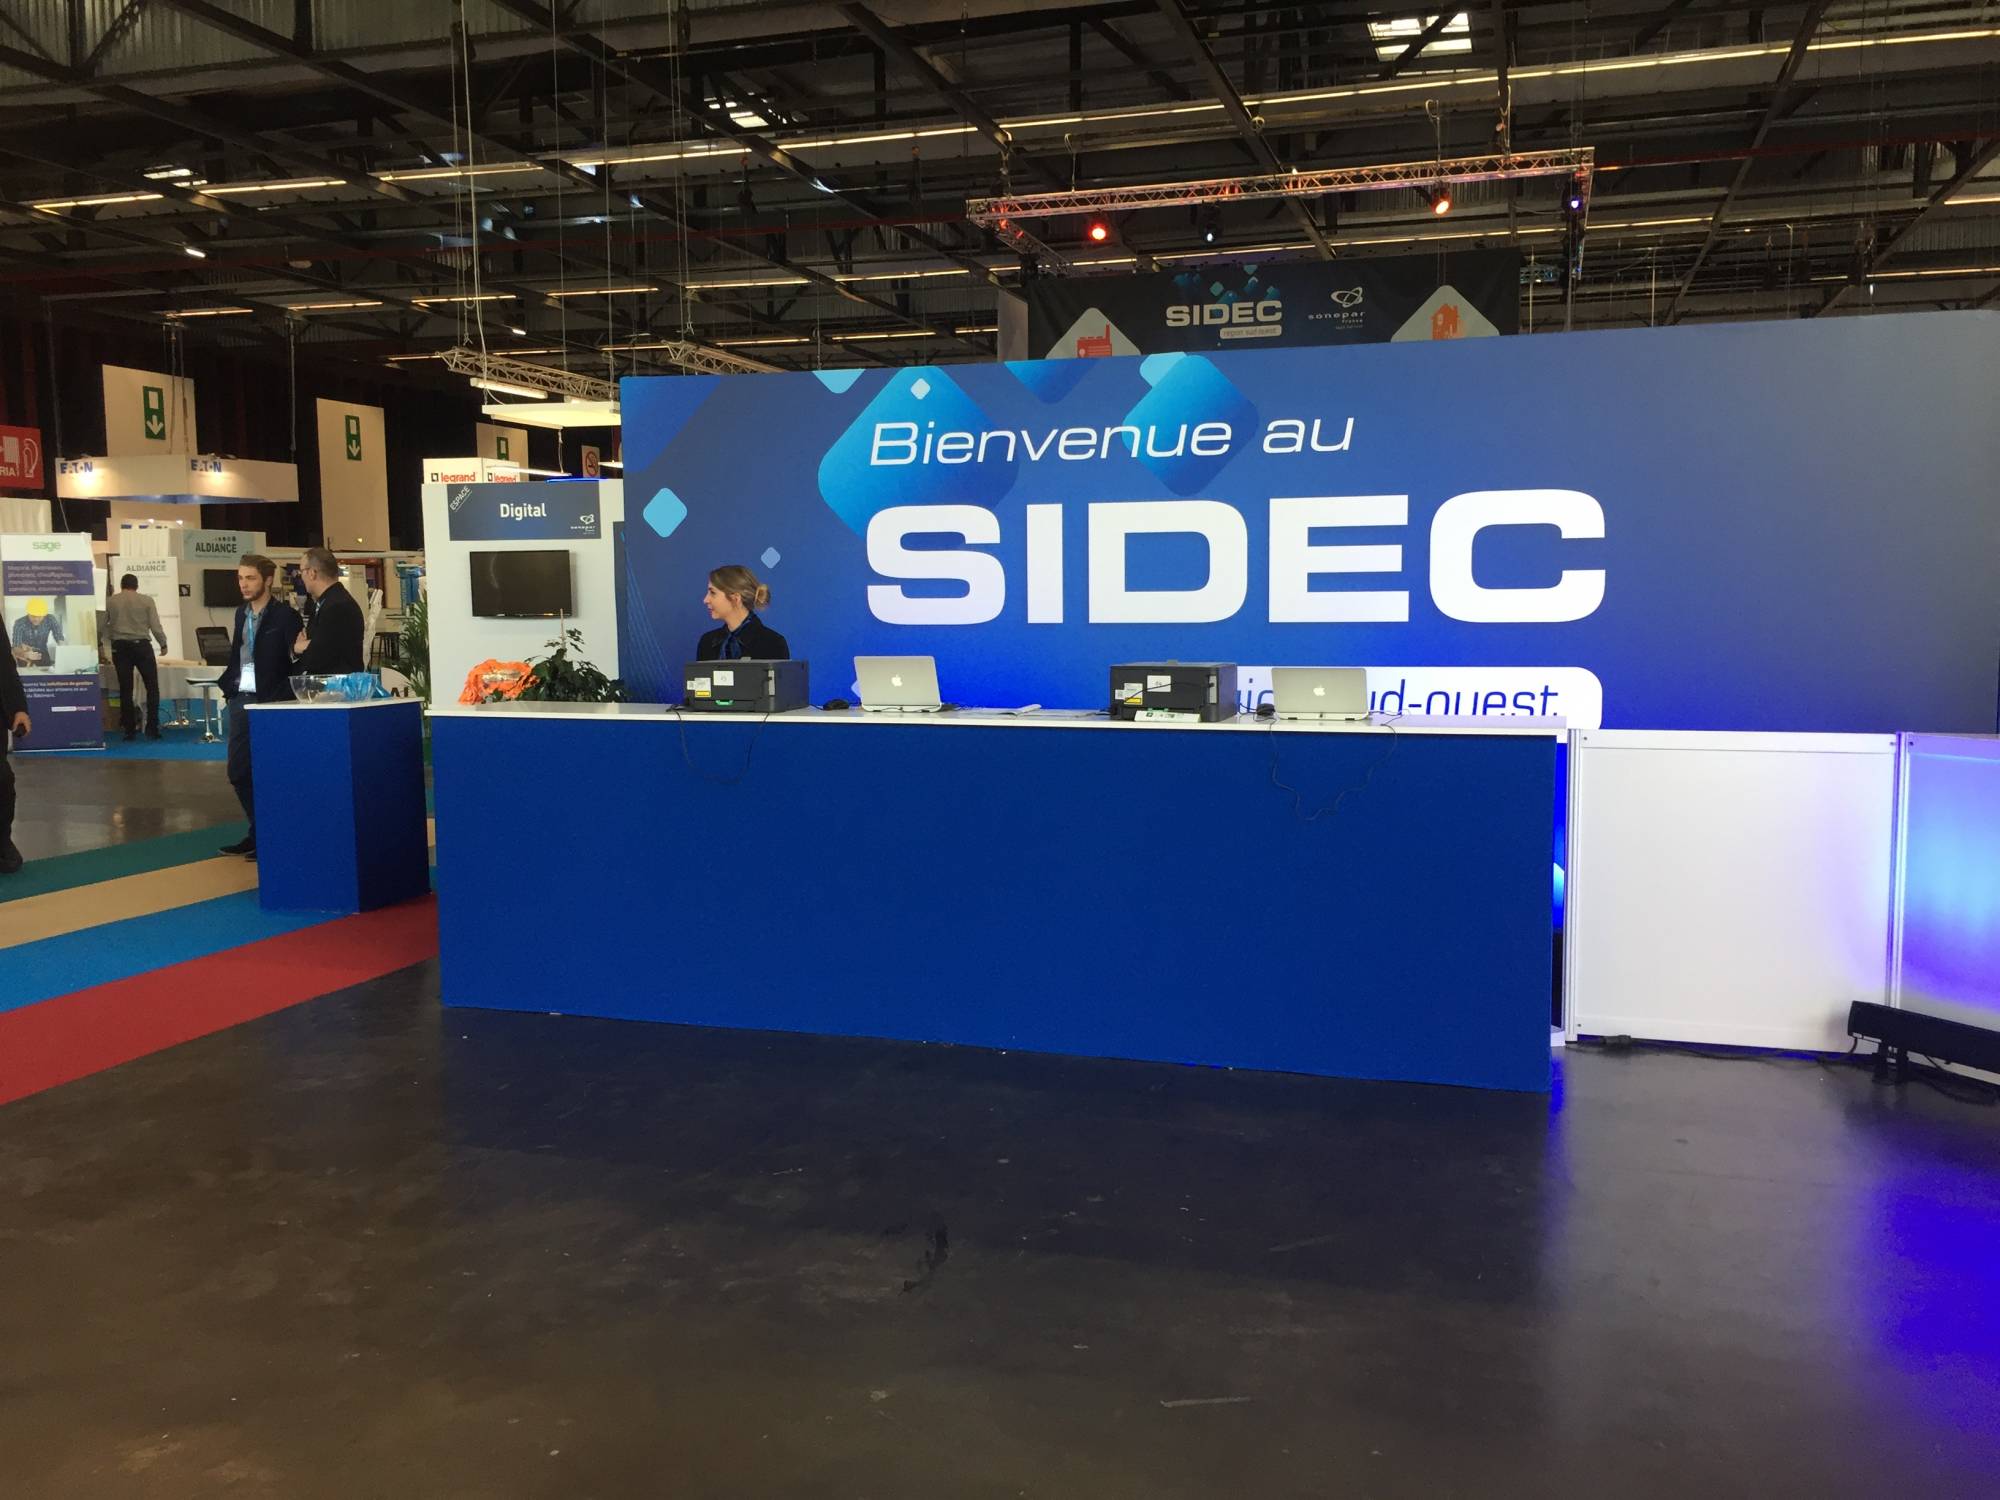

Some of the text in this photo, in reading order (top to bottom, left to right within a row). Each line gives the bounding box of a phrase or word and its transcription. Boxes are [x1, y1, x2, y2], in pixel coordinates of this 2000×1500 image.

[1165, 300, 1283, 327] SIDEC
[1308, 312, 1365, 320] sonepar
[869, 416, 1355, 467] Bienvenue au
[441, 472, 476, 483] legrand
[449, 485, 471, 511] ESPACE
[500, 503, 547, 521] Digital
[195, 542, 237, 554] ALDIANCE
[866, 488, 1606, 626] SIDEC
[126, 564, 167, 572] ALDIANCE
